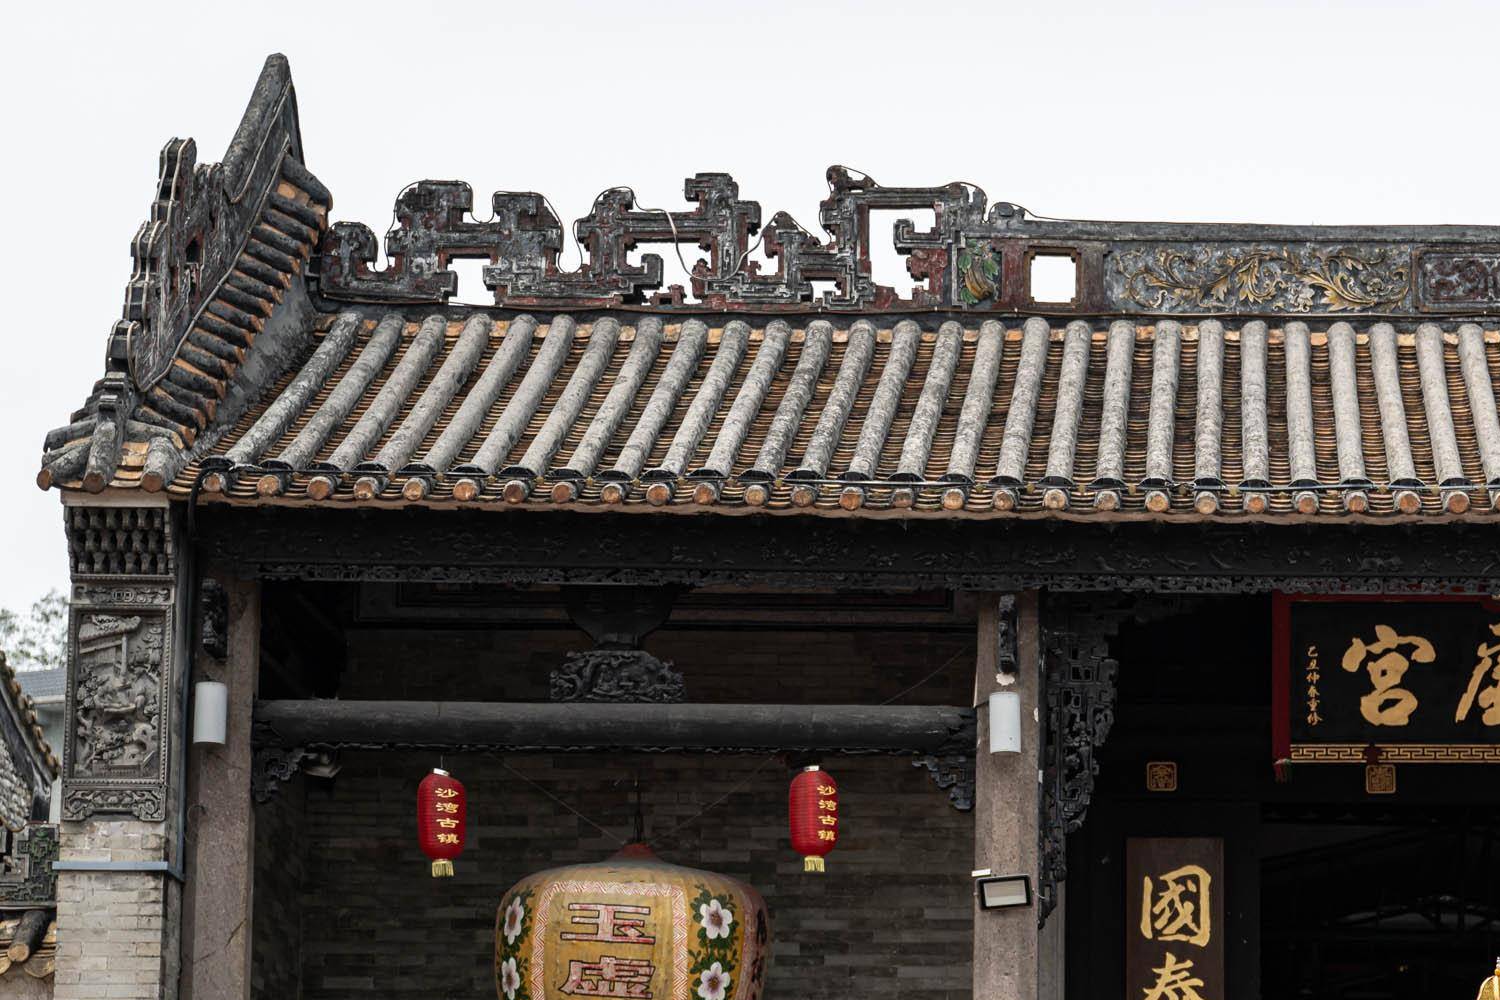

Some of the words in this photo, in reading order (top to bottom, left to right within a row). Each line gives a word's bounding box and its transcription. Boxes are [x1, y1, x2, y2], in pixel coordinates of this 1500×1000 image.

[434, 787, 460, 844] 沙湾古镇
[816, 784, 837, 841] 沙湾古镇
